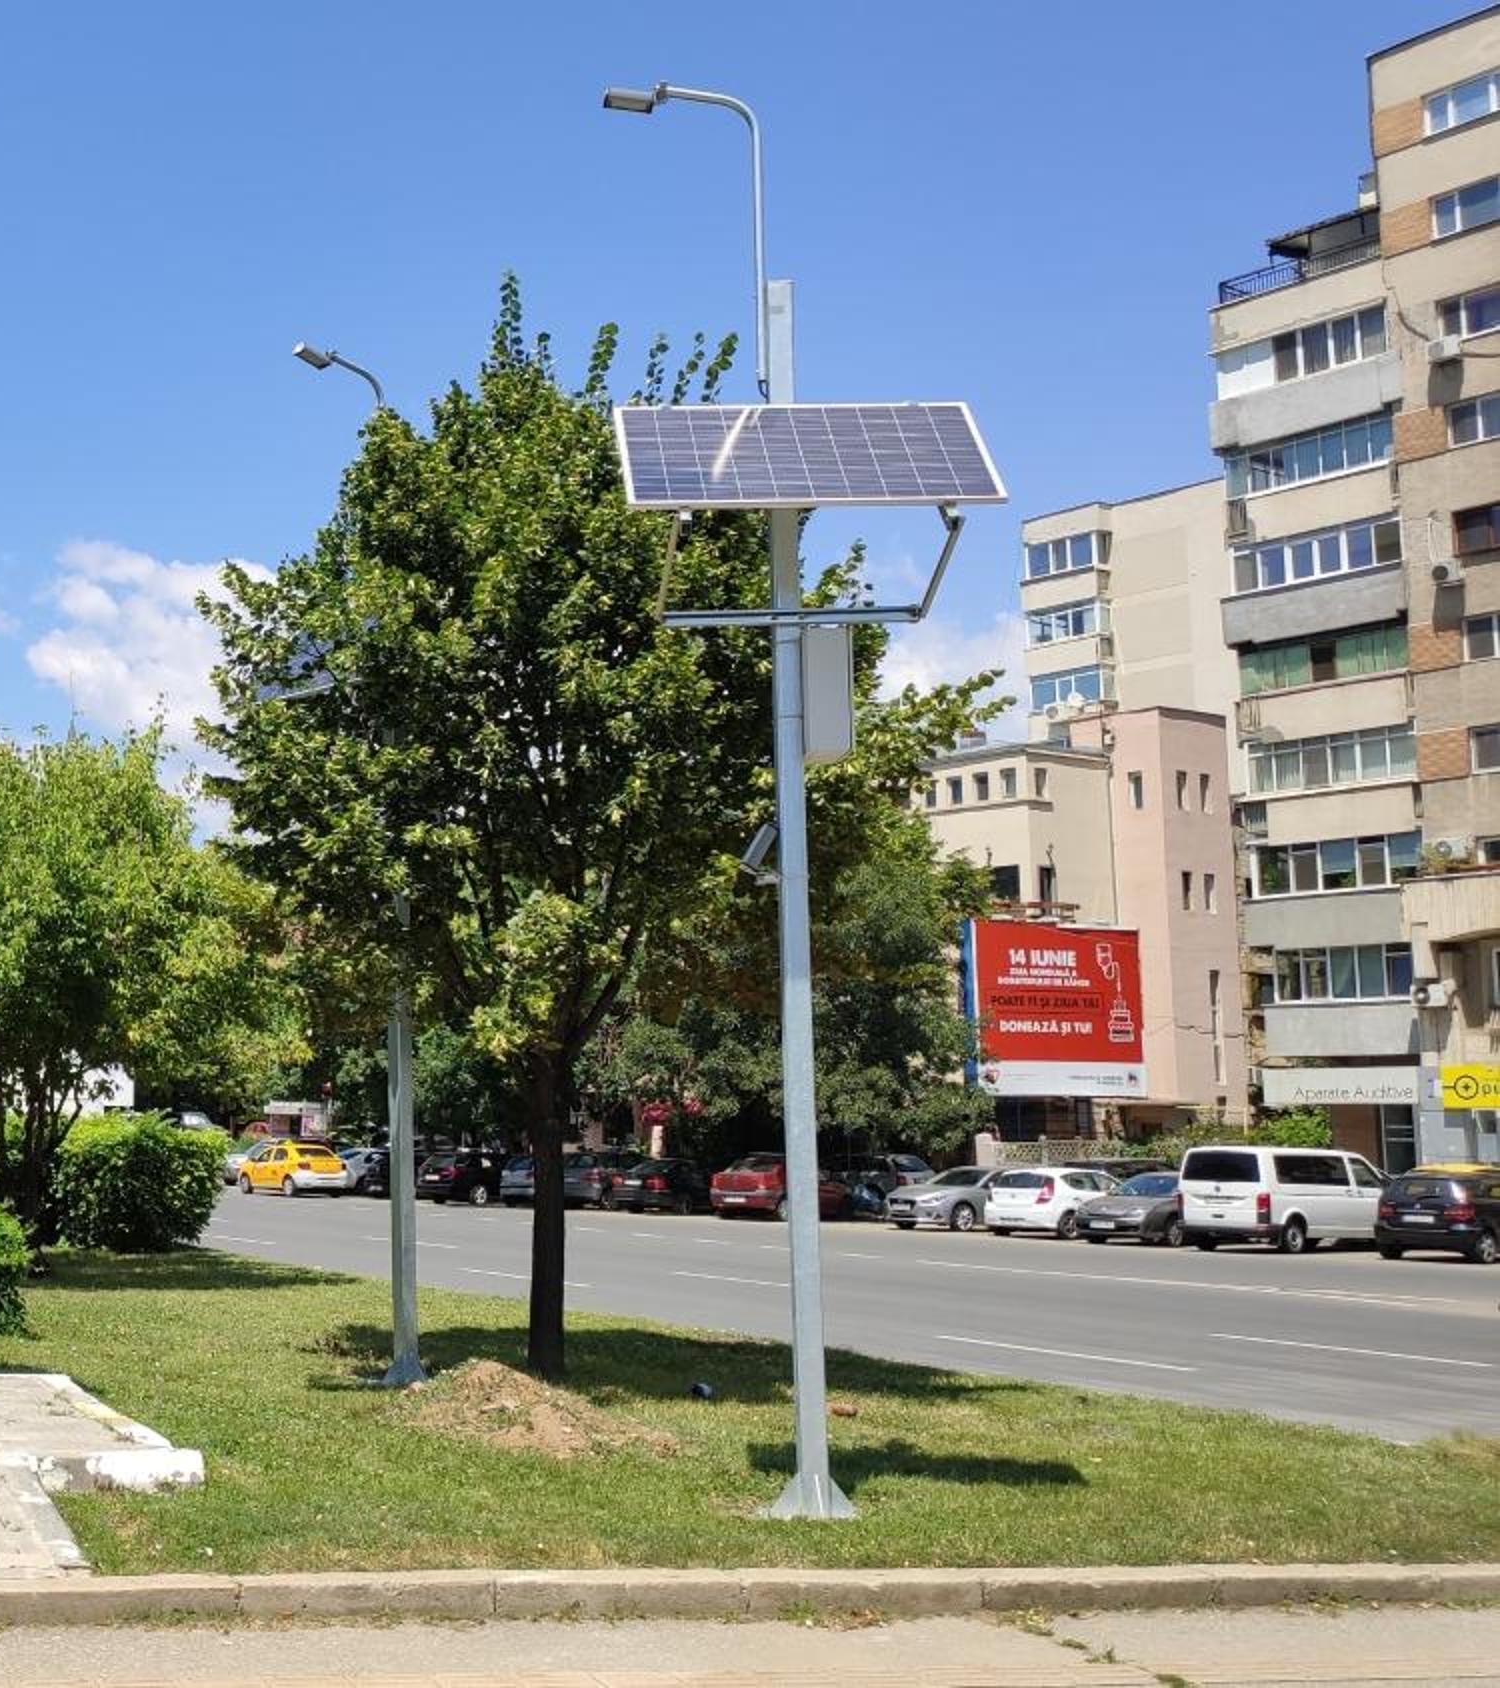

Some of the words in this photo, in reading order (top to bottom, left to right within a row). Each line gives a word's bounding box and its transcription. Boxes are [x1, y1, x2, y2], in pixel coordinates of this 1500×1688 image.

[1009, 948, 1026, 965] 14
[1030, 949, 1077, 966] IUNIE
[1054, 998, 1079, 1008] ZIUA
[1000, 1019, 1059, 1033] DONEAZĂ
[1294, 1086, 1350, 1100] Aparate
[1353, 1085, 1413, 1098] Auditive
